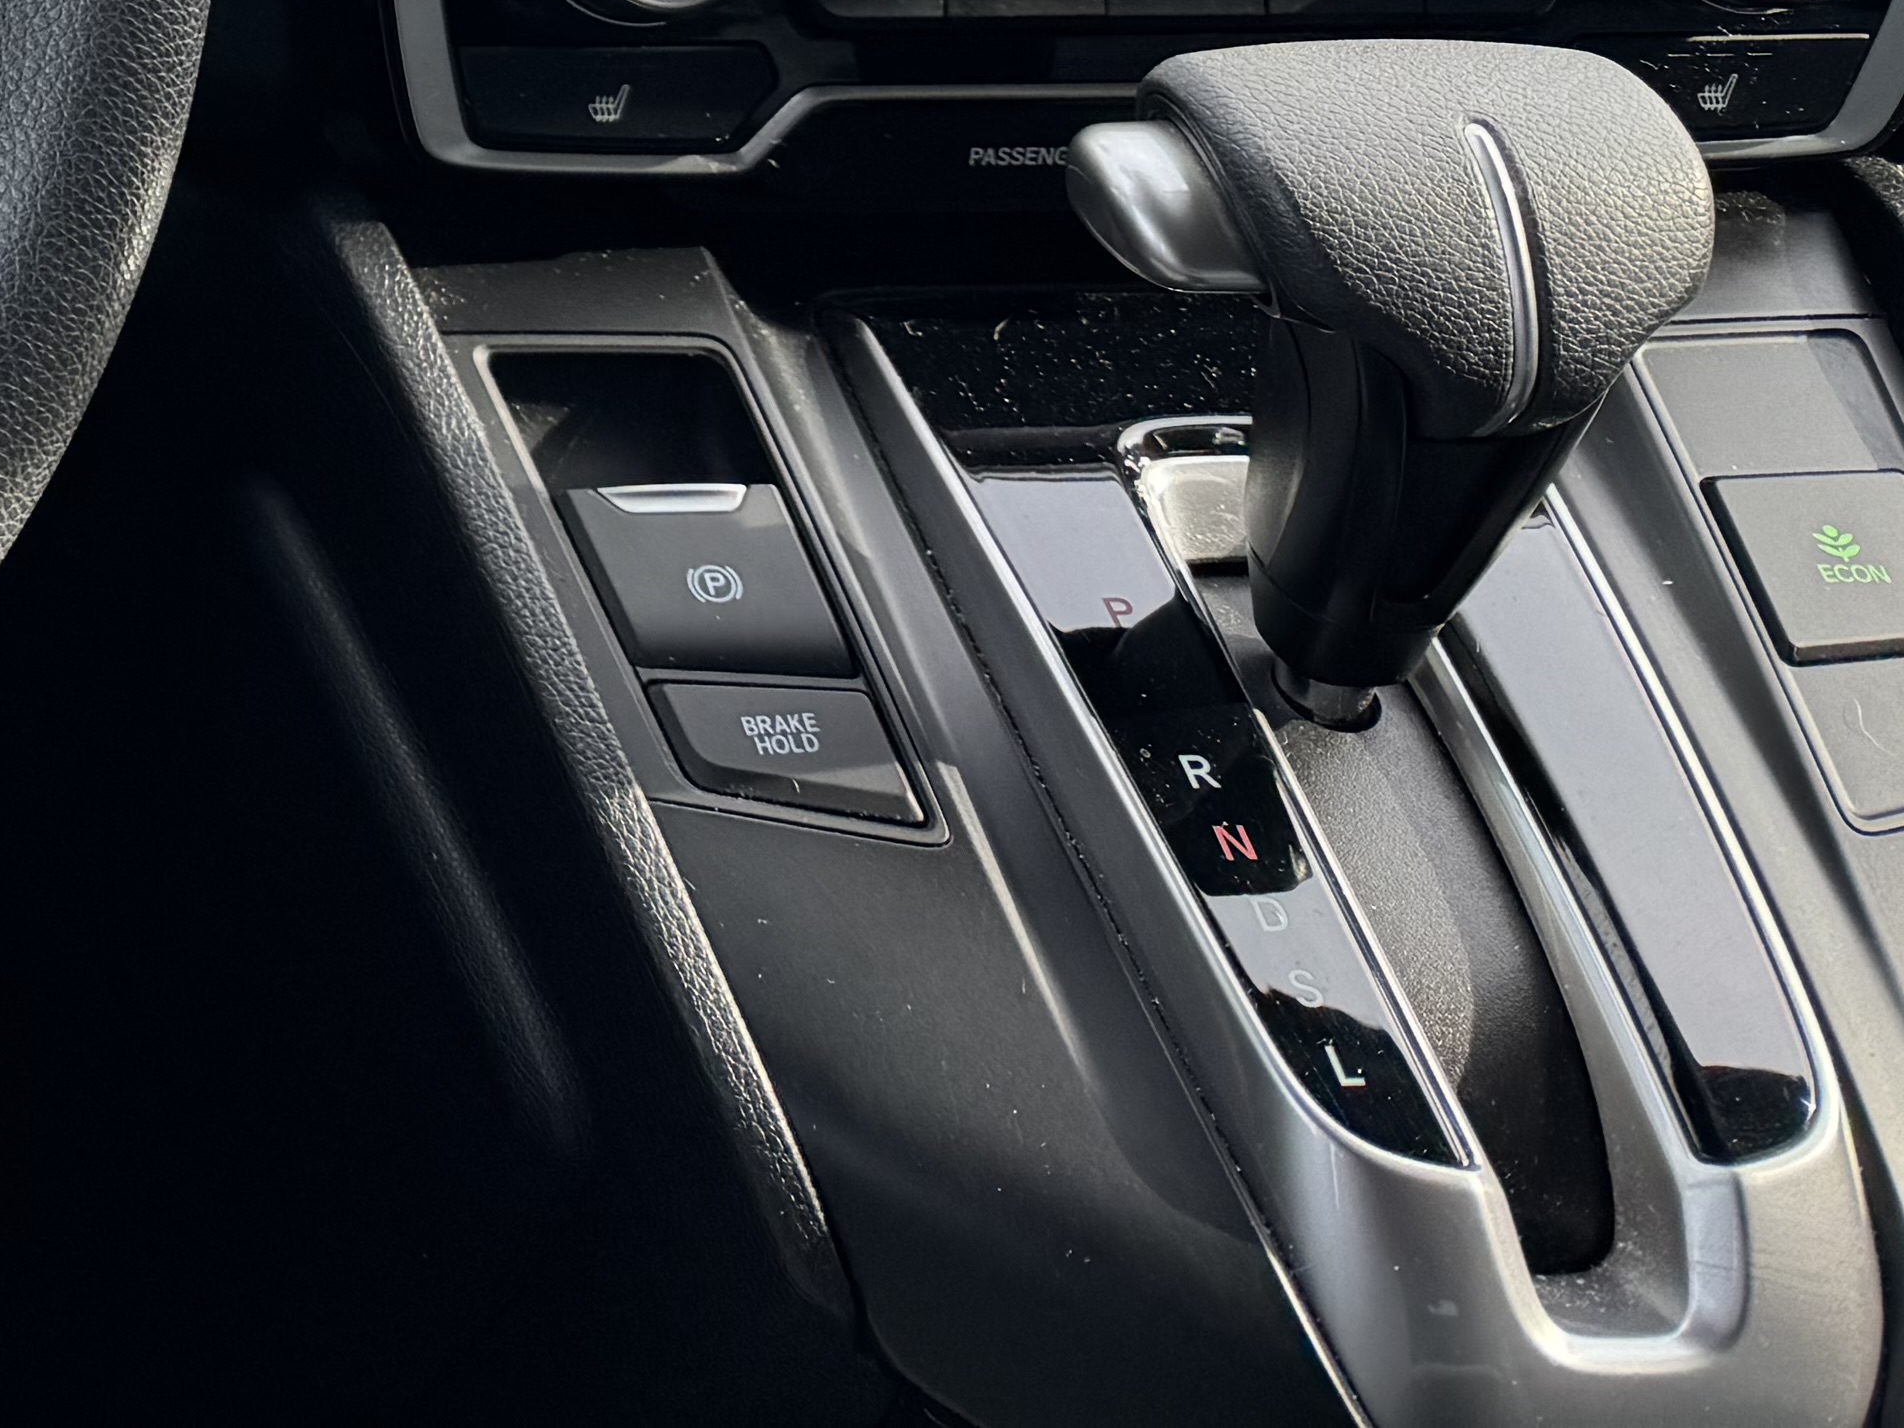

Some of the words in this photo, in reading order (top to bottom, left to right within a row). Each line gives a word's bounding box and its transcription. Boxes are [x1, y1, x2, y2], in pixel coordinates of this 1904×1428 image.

[968, 146, 1069, 166] PASSENG
[1816, 564, 1892, 584] ECON
[1101, 597, 1133, 627] P
[740, 712, 821, 737] BRAKE
[753, 733, 820, 755] HOLD
[1178, 755, 1222, 789] R
[1212, 824, 1258, 861] N
[1251, 896, 1289, 932] D
[1288, 969, 1324, 1008] S
[1324, 1044, 1366, 1086] L
